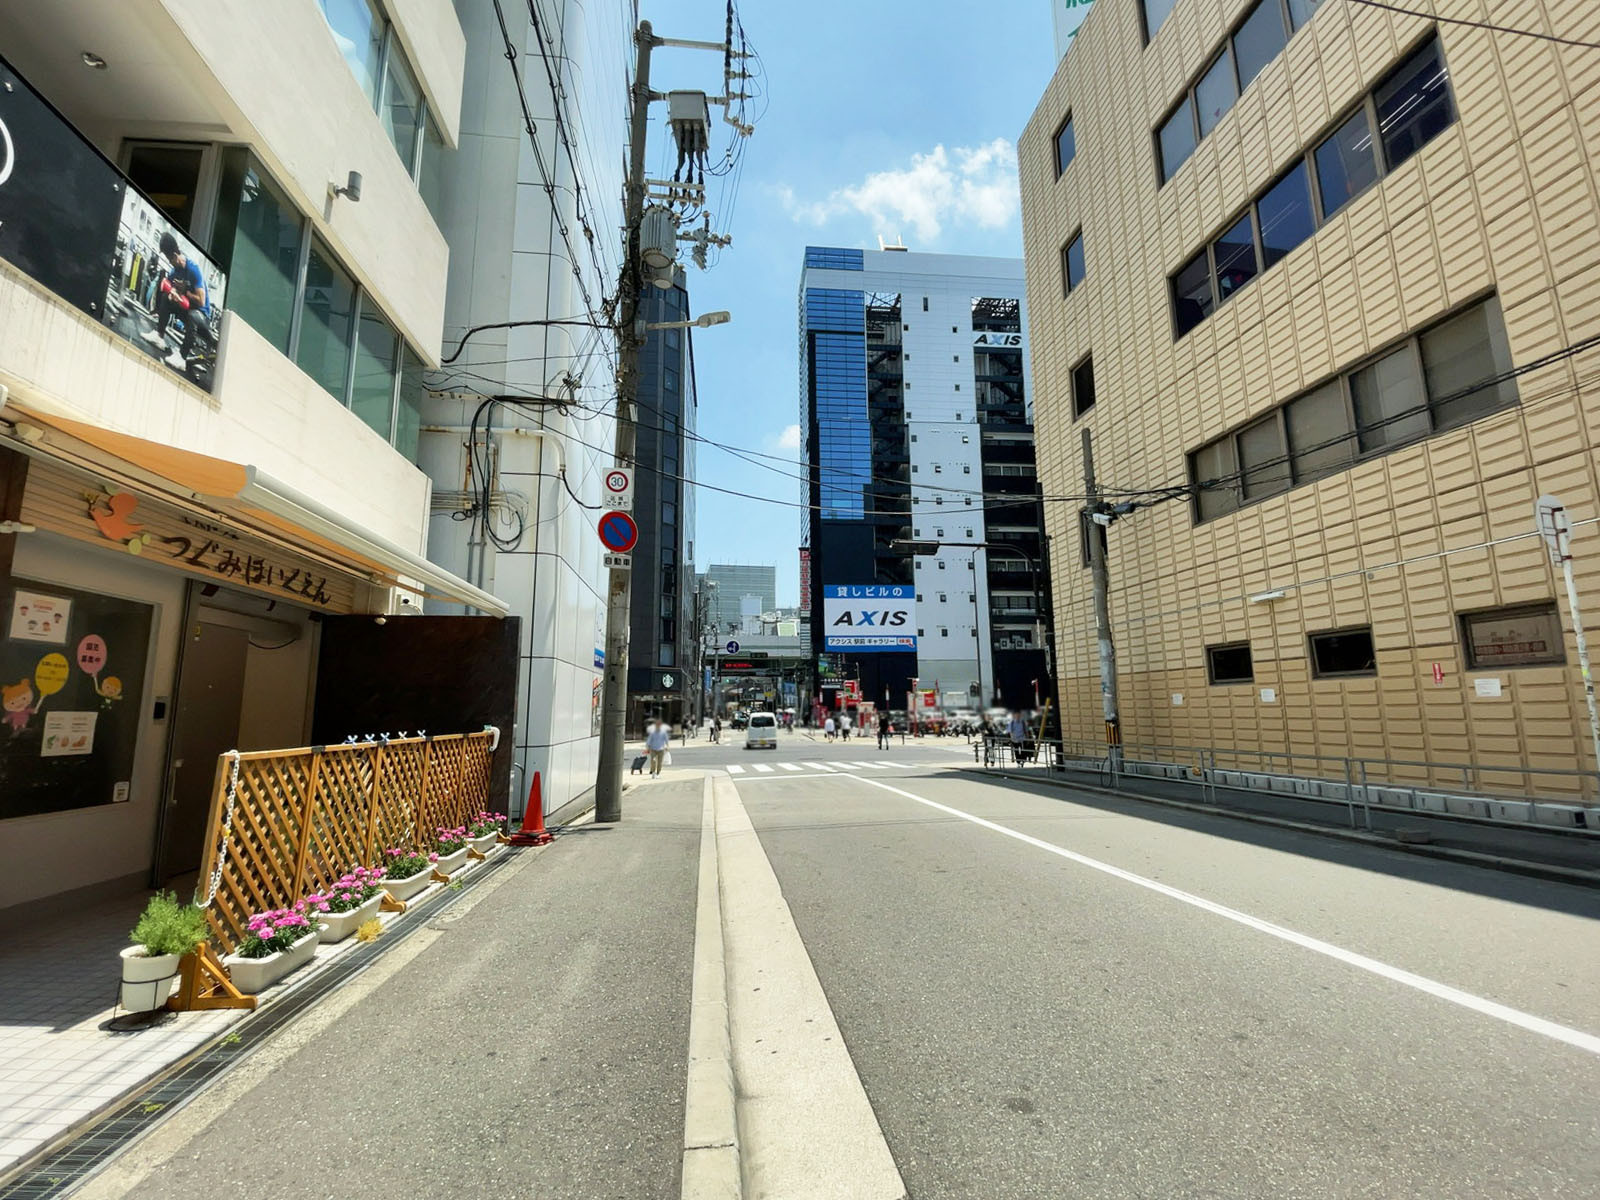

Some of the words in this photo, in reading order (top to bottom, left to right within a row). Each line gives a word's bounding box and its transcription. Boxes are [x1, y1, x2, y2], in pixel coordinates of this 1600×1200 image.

[974, 334, 1022, 346] AXIS
[611, 477, 624, 487] 30
[163, 536, 331, 605] つぐみほいくえん
[837, 586, 903, 597] 貸しビルの
[833, 610, 908, 627] AXIS
